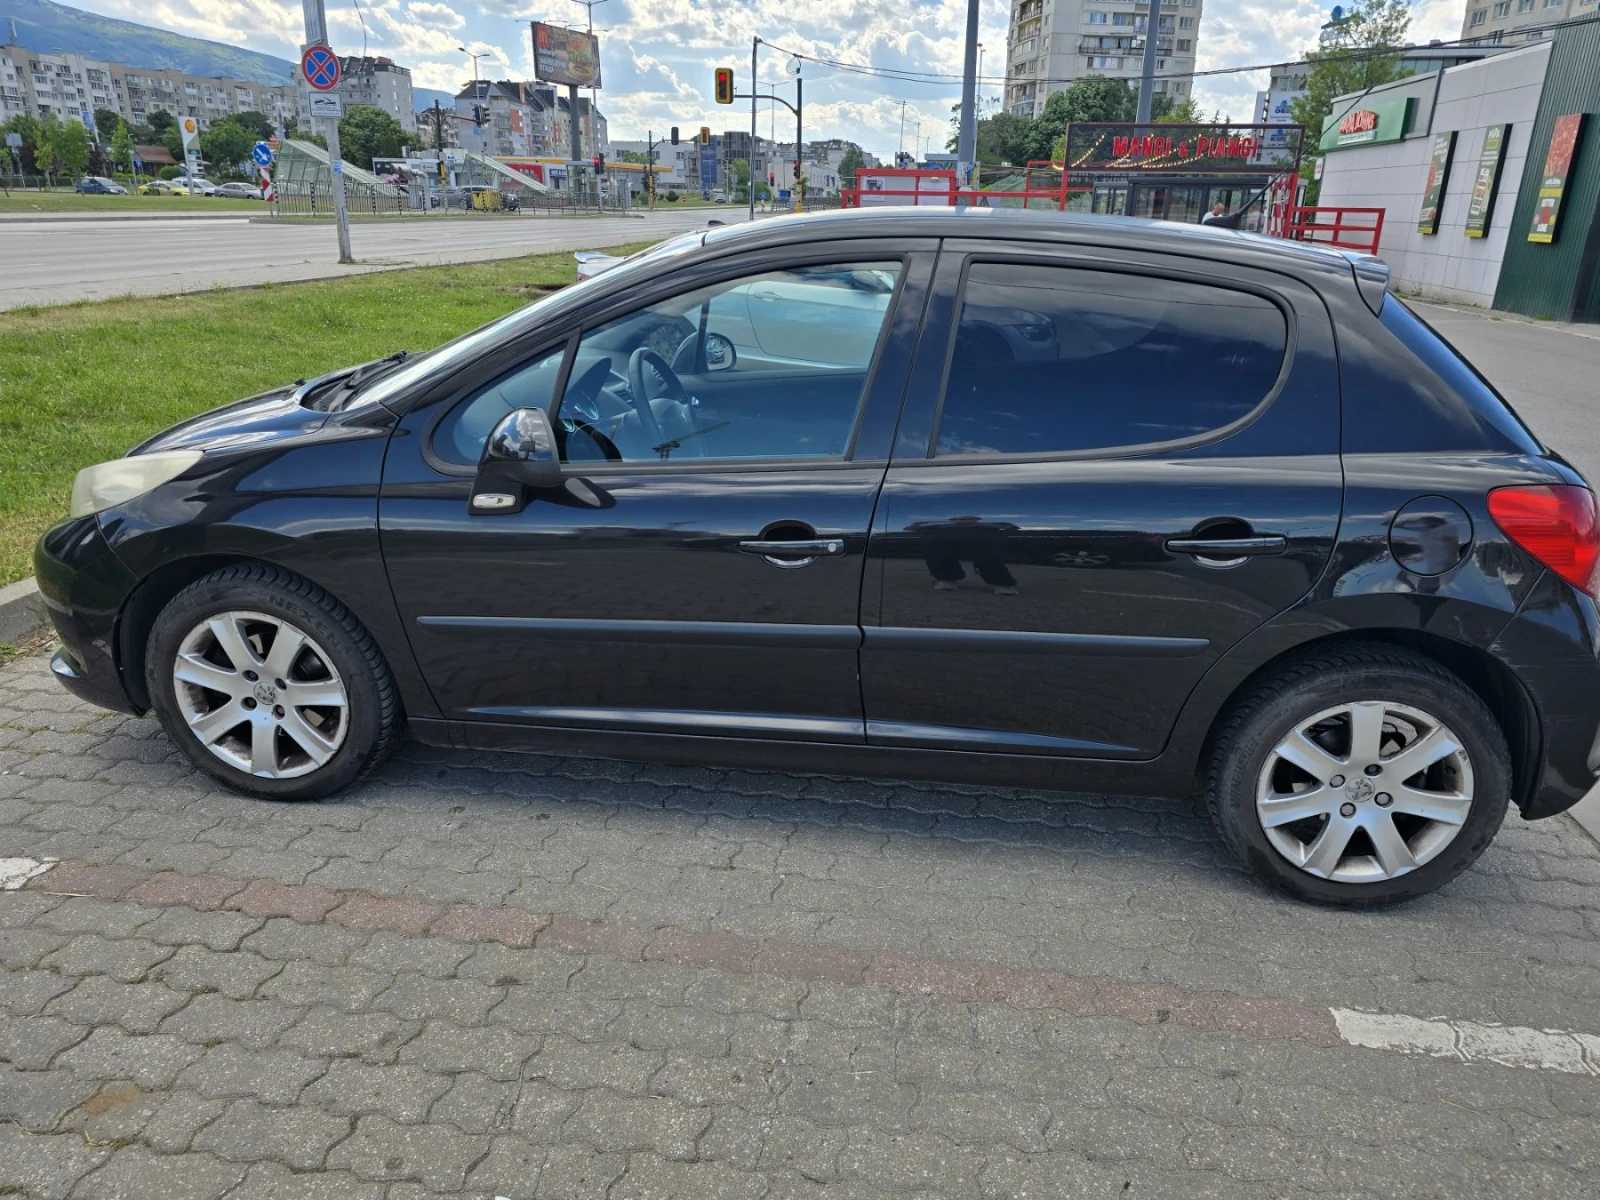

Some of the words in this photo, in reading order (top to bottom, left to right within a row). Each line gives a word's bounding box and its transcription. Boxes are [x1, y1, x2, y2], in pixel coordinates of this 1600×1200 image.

[1112, 136, 1171, 158] MANGI
[1178, 141, 1187, 157] &
[1196, 136, 1259, 158] PIANGI
[268, 595, 343, 648] NEXEN
